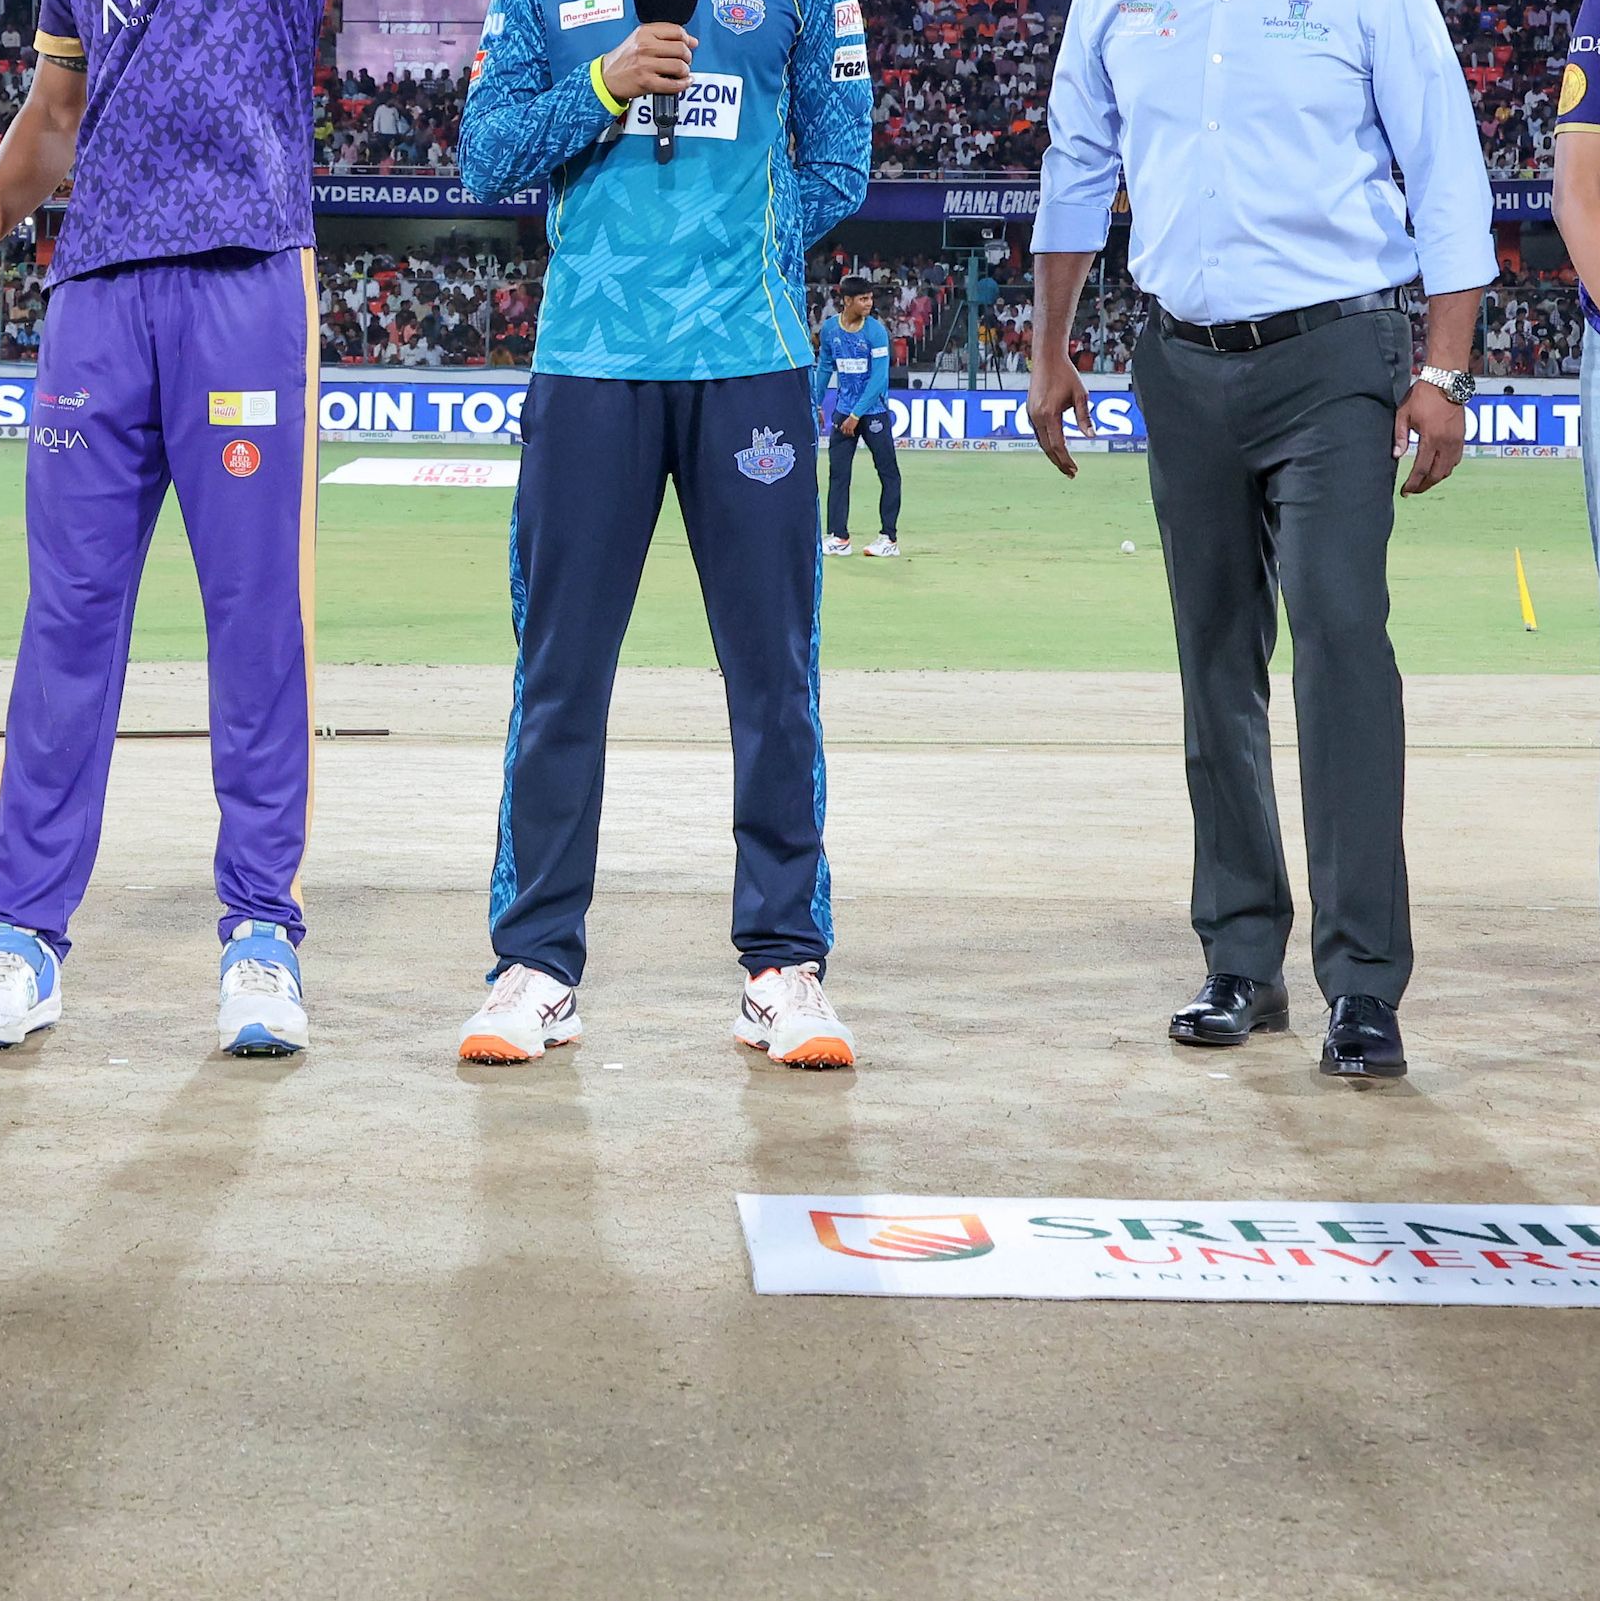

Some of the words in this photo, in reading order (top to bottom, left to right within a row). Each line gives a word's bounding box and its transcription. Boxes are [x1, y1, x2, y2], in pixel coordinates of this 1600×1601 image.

[943, 190, 999, 214] MANA
[58, 395, 85, 408] Group
[34, 425, 89, 449] MOHA
[742, 448, 789, 461] HYDERABAD
[229, 461, 252, 469] ROSE
[412, 476, 441, 484] FM
[444, 476, 488, 484] 93.5
[1094, 1270, 1299, 1284] KINDLE
[1338, 1274, 1439, 1286] THE
